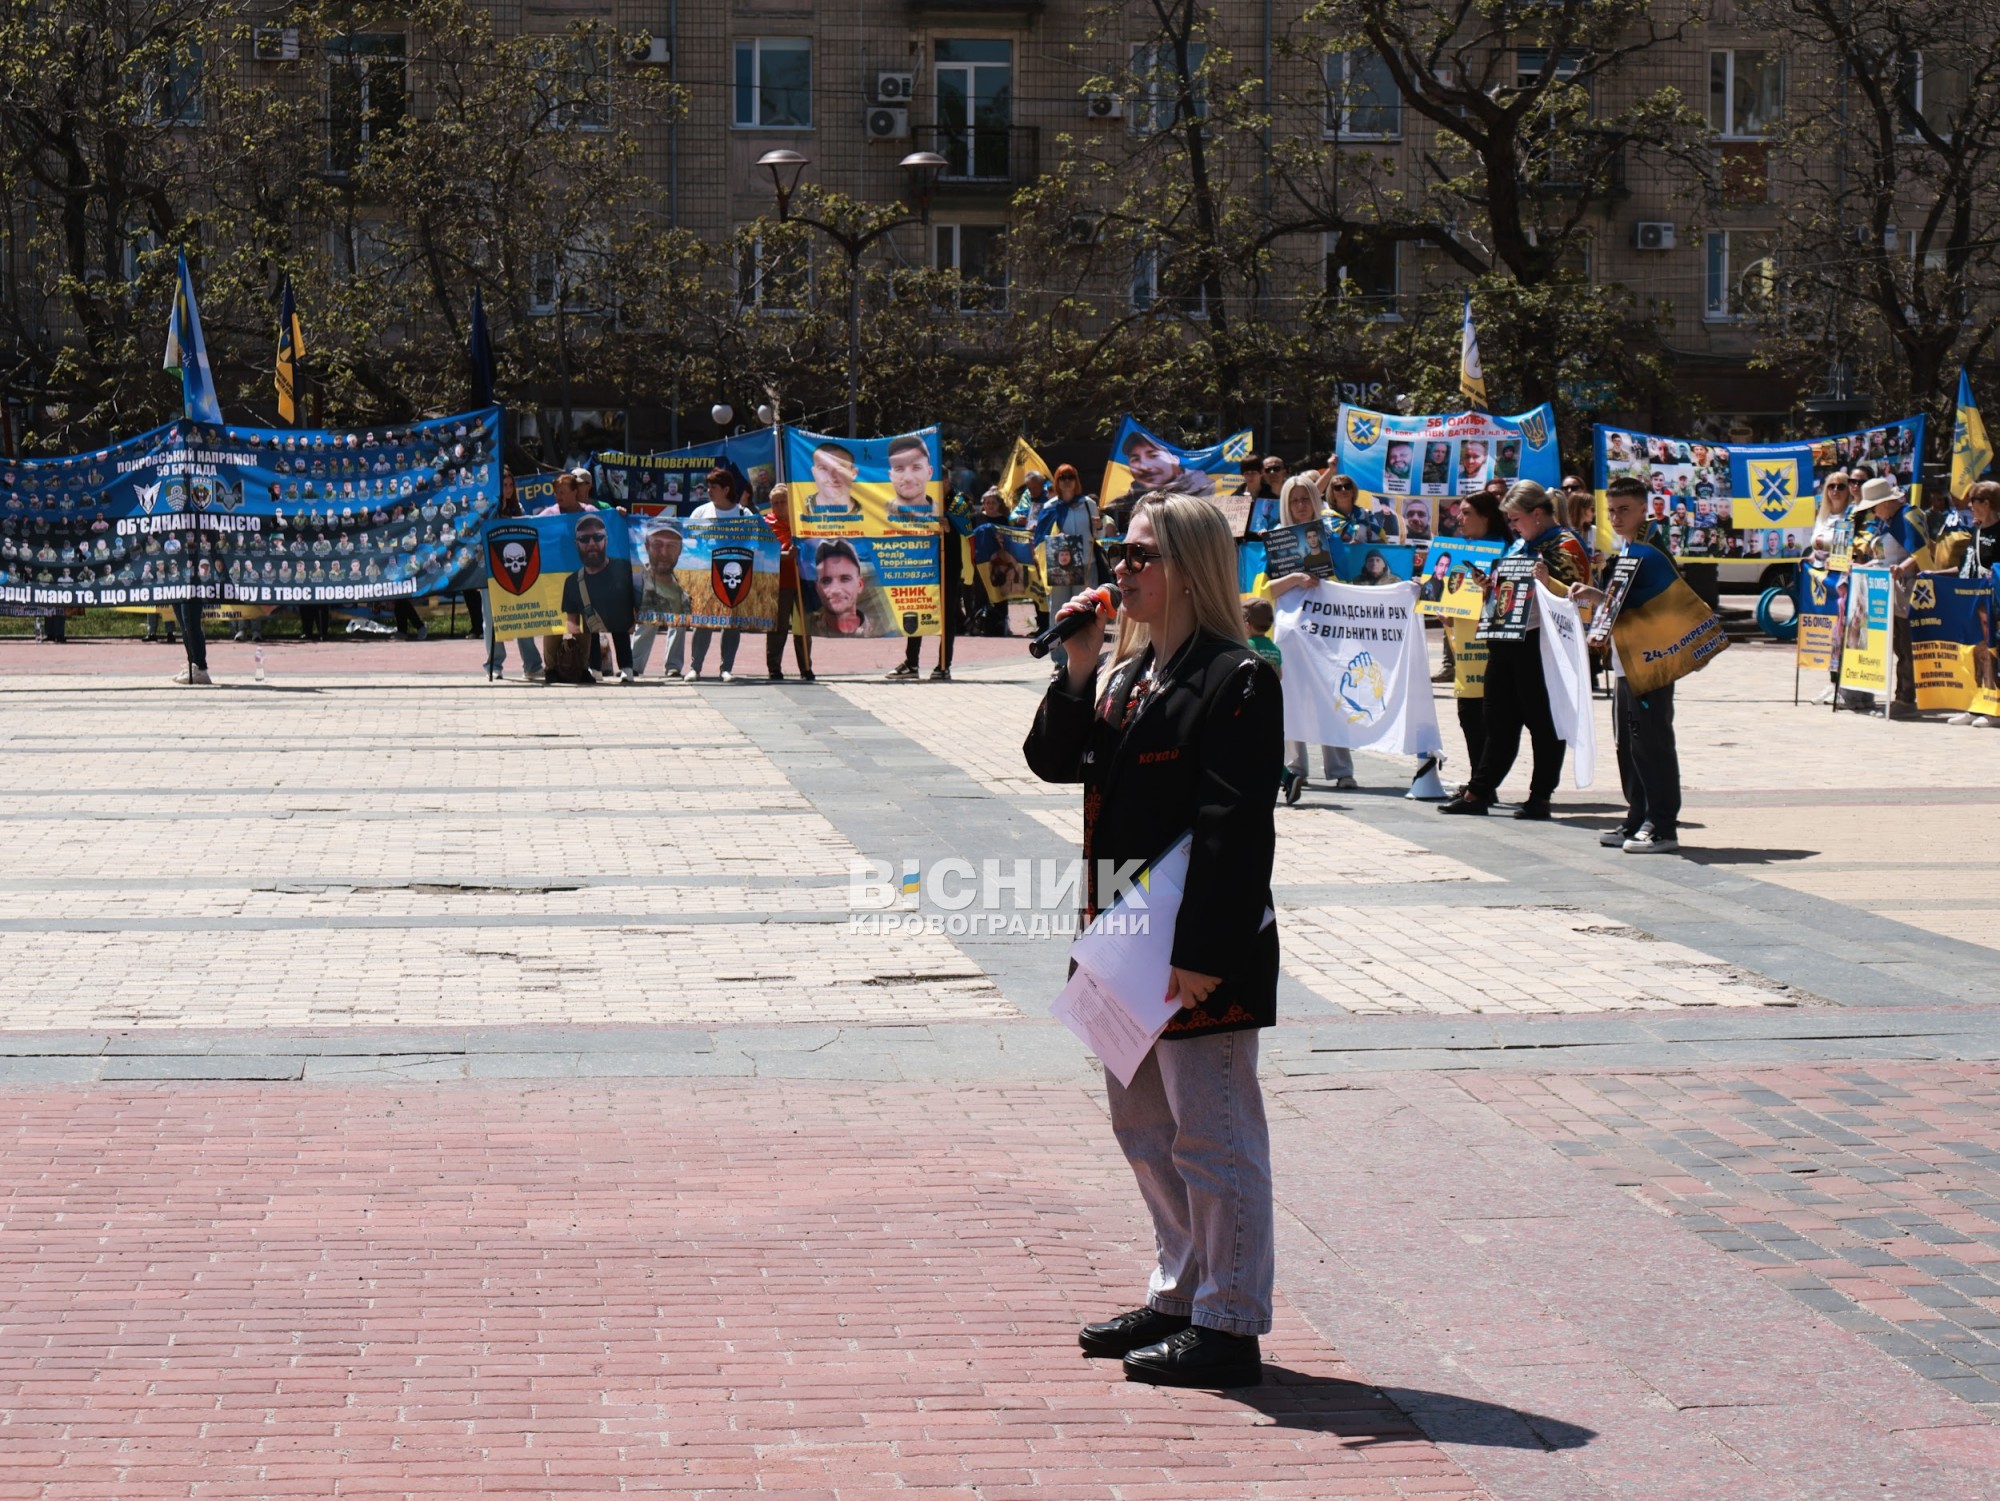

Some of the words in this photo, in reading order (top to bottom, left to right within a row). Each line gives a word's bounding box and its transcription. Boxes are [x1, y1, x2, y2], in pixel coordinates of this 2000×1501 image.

[117, 448, 195, 473] ПОКРОВСЬКИЙ
[197, 450, 258, 466] НАПРЯМОК
[640, 455, 651, 467] ТА
[655, 457, 715, 468] ПОВЕРНУТИ
[156, 465, 170, 477] 59
[171, 464, 217, 477] БРИГАДА
[116, 514, 196, 536] ОБ'ЄДНАНІ
[199, 514, 261, 533] НАДІЄЮ
[872, 541, 930, 550] ЖАРОВЛЯ
[877, 551, 905, 559] Федір
[35, 590, 71, 603] маю
[75, 590, 98, 605] те,
[101, 589, 127, 605] що
[130, 588, 150, 602] не
[153, 582, 220, 600] вмирає!
[224, 583, 258, 601] Віру
[261, 588, 271, 600] в
[274, 586, 311, 600] твоє
[315, 577, 417, 601] повернення!
[891, 587, 926, 597] ЗНИК
[1302, 600, 1385, 620] ГРОМАДСЬКИЙ
[1389, 606, 1407, 620] РУХ
[1802, 617, 1812, 627] 56
[1643, 643, 1680, 663] 24-ТА
